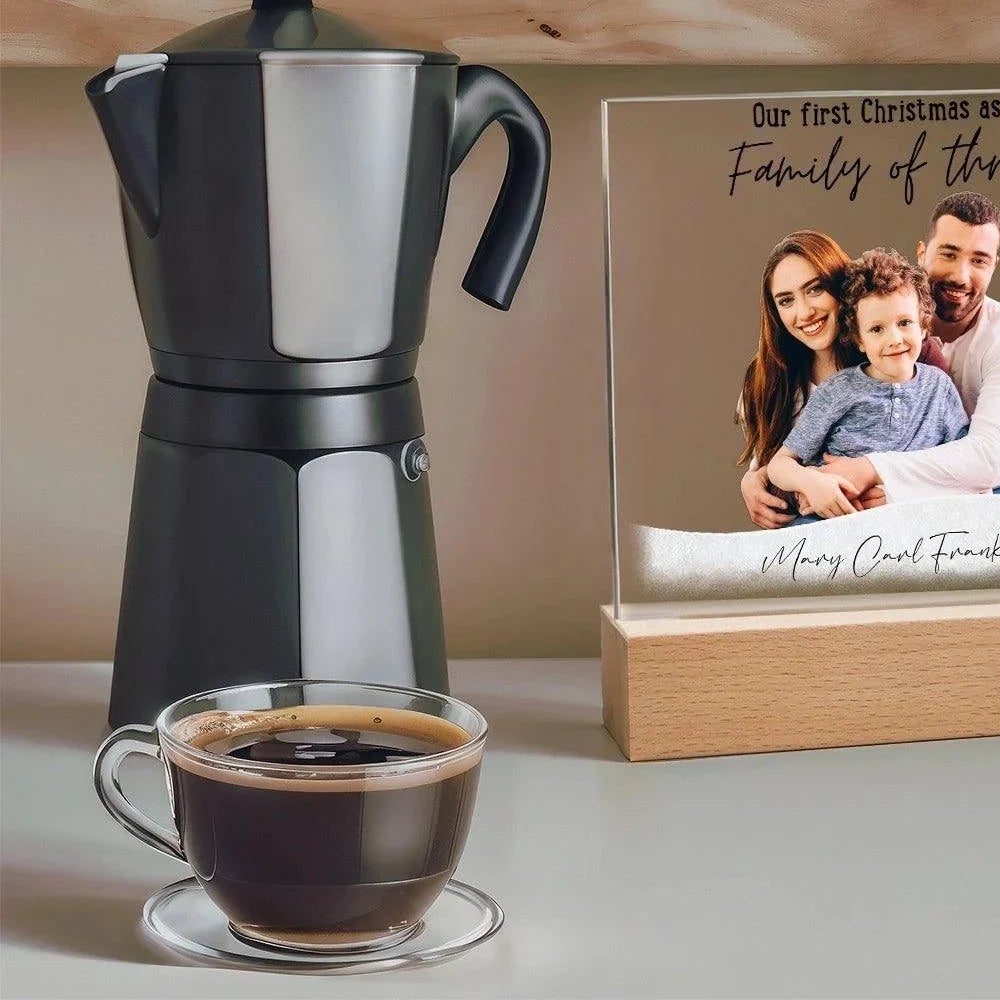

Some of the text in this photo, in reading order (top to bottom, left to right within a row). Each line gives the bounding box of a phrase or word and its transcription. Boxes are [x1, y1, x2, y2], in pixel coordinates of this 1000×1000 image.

[753, 102, 791, 128] Our
[801, 101, 851, 126] first
[861, 98, 969, 124] Christmas
[979, 99, 1000, 120] as
[728, 136, 871, 201] Family
[889, 130, 927, 205] of
[762, 537, 844, 581] Mary
[853, 534, 923, 578] Carl
